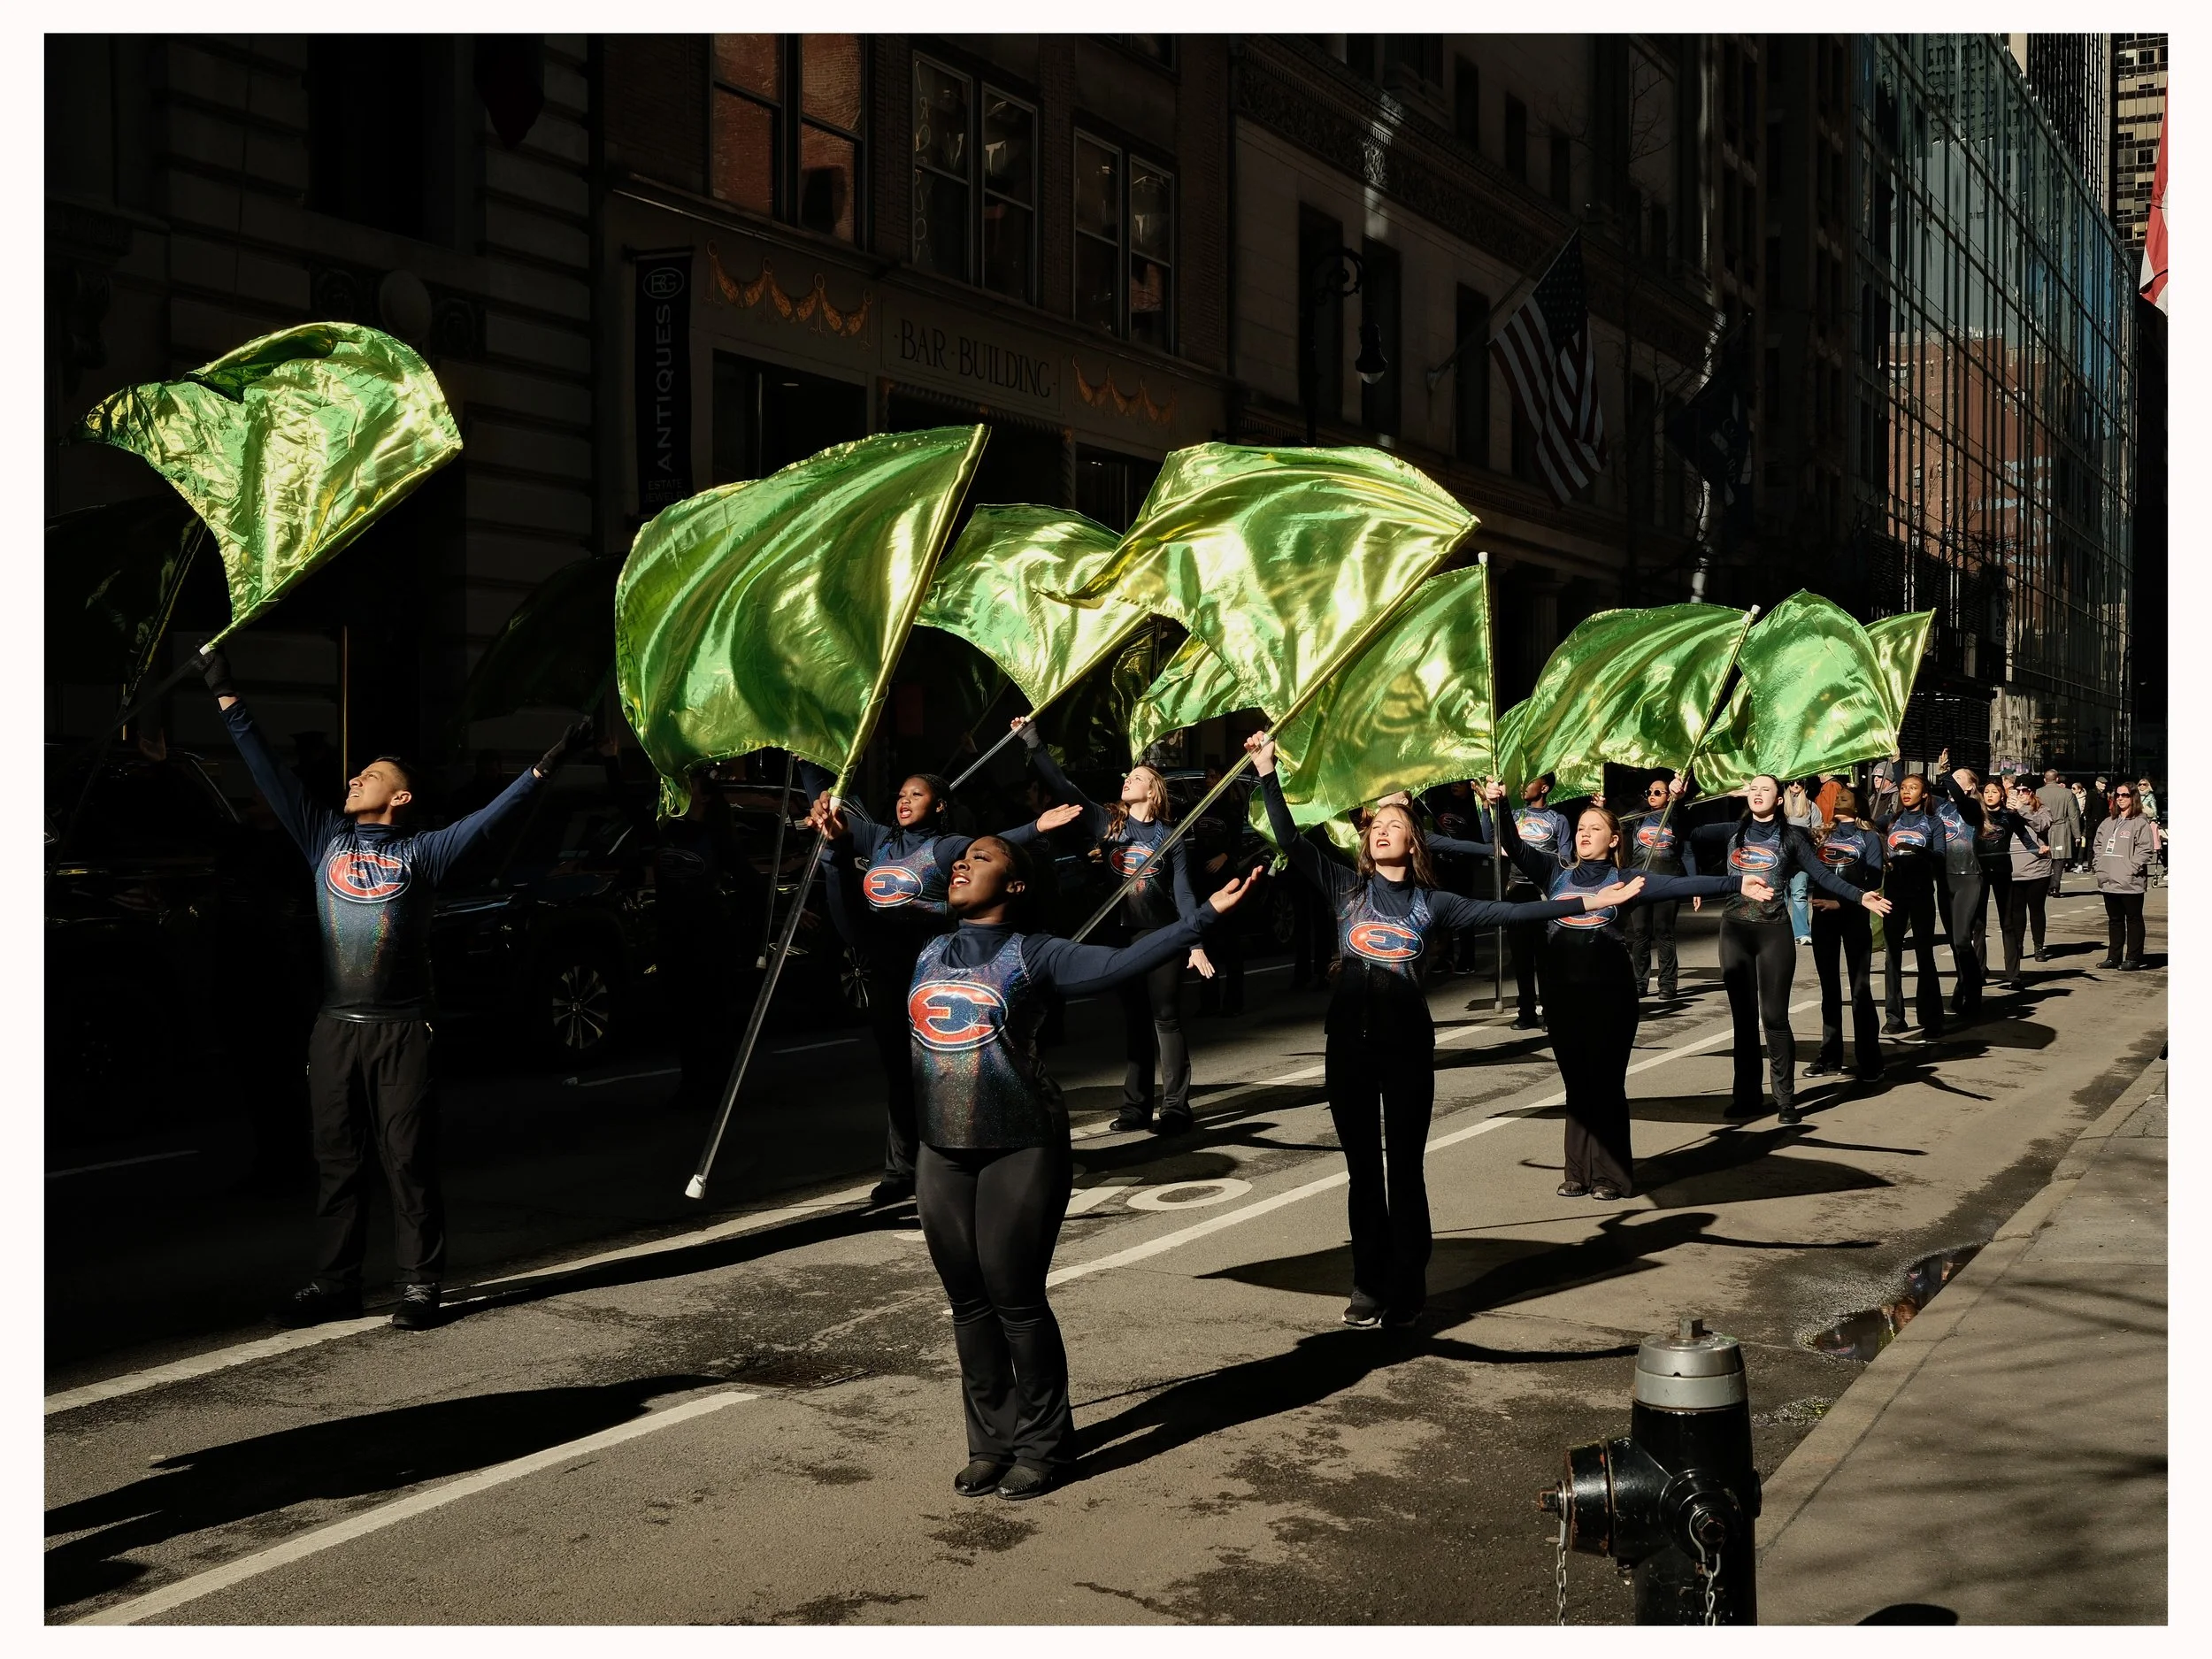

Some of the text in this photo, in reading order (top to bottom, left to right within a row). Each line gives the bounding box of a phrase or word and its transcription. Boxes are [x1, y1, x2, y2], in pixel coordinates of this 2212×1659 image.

[656, 303, 674, 473] ANTIQUES
[899, 319, 1051, 398] BAR BUILDING
[648, 479, 684, 490] ESTATE
[909, 982, 1004, 1049] E
